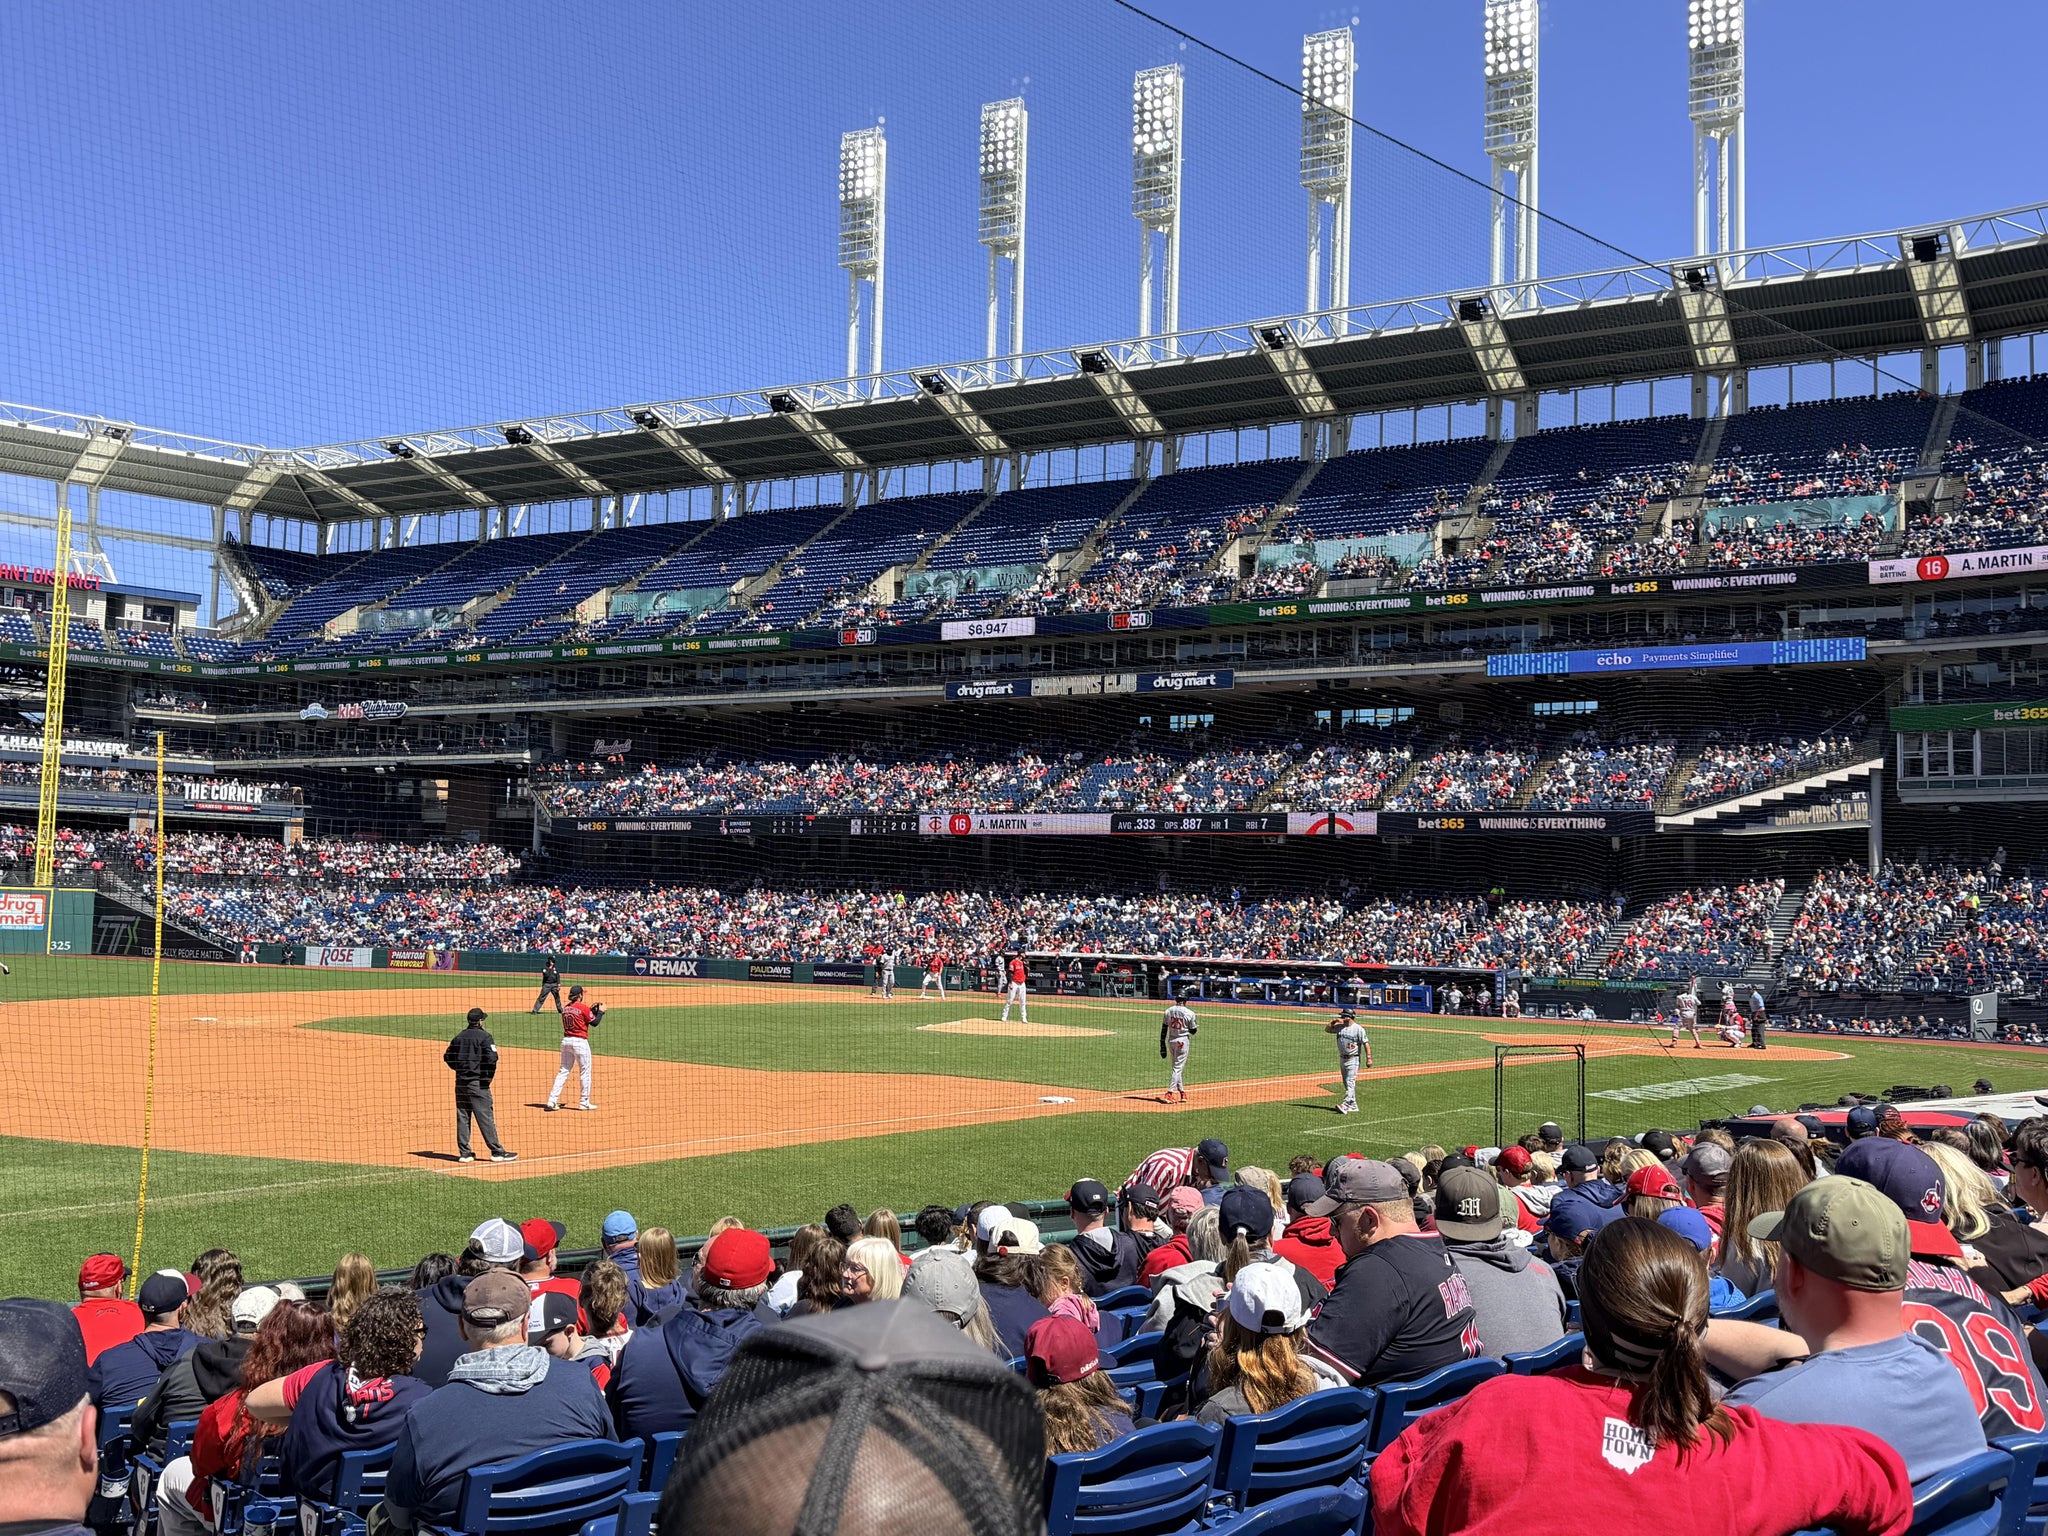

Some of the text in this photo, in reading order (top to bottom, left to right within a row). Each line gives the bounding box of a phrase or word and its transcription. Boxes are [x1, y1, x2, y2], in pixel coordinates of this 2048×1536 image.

[1925, 561, 1942, 576] 16
[1962, 558, 1975, 571] A.
[1978, 553, 2033, 570] MARTIN
[997, 573, 1030, 587] WYNN
[1880, 571, 1907, 579] BATTING
[1611, 580, 1658, 595] bet365
[1672, 577, 1722, 591] WINNING
[1730, 572, 1797, 588] EVERYTHING
[1426, 593, 1468, 606] bet365
[1481, 590, 1526, 603] WINNING
[1533, 585, 1595, 600] EVERYTHING
[1259, 605, 1298, 617] bet365
[1308, 601, 1350, 615] WINNING
[1355, 597, 1411, 612] EVERYTHING
[1114, 612, 1147, 628] 50/50
[968, 621, 1008, 636] $6,947
[672, 642, 701, 651] bet365
[708, 639, 738, 650] WINNING
[741, 637, 780, 648] EVERYTHING
[842, 631, 872, 646] 50/50
[20, 648, 50, 660] bet36
[456, 653, 481, 663] bet365
[561, 647, 588, 657] bet365
[1596, 650, 1739, 666] echo Payments Simplified
[160, 657, 192, 673] bet365
[266, 663, 289, 672] bet365
[358, 658, 382, 669] bet365
[1153, 674, 1217, 690] drug mart
[957, 683, 1014, 698] drug mart
[338, 703, 364, 719] kids
[1993, 707, 2048, 721] bet365
[66, 740, 130, 754] BREWERY
[184, 782, 263, 804] THE CORNER
[1840, 802, 1869, 822] CLUB
[577, 821, 607, 831] bet365
[615, 821, 645, 831] WINNING
[650, 821, 692, 831] EVERYTHING
[891, 822, 917, 831] 2 0 2
[955, 818, 966, 830] 16
[979, 819, 988, 831] A.
[989, 819, 1027, 831] MARTIN
[1118, 818, 1268, 830] AVG .333 OPS .887 HR 1 RBI 7
[1418, 818, 1465, 829] bet365
[1479, 817, 1530, 830] WINNING
[1537, 817, 1607, 829] EVERYTHING
[0, 913, 40, 925] mart
[50, 941, 71, 951] 325
[178, 949, 200, 959] PEOPLE
[319, 948, 355, 967] ROSE
[391, 951, 426, 960] PHANTOM
[389, 959, 424, 968] FIREWORKS
[769, 966, 792, 975] DAVIS
[1729, 982, 1766, 990] LEXS
[1903, 1260, 1992, 1310] AUGHN
[1603, 1436, 1651, 1461] TOWN
